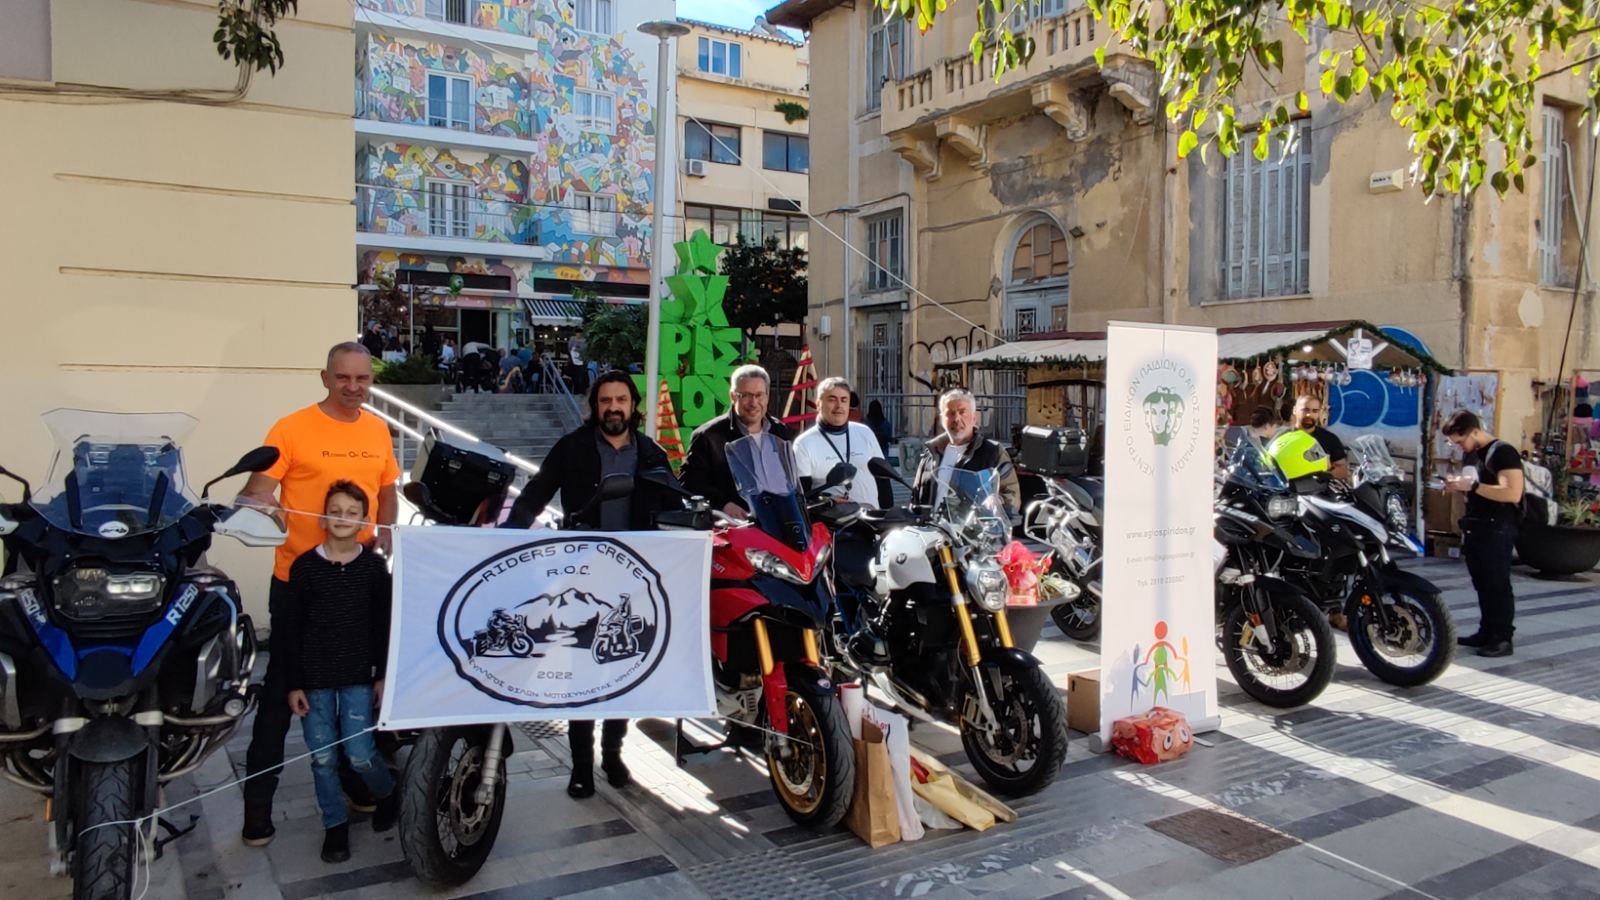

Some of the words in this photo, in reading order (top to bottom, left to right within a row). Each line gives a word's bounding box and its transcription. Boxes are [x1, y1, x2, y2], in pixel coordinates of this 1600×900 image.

[1140, 359, 1177, 380] ΠΑΙΔΙΩΝ
[1126, 436, 1155, 477] ΚΕΝΤΡΟ
[482, 545, 557, 582] RIDERS
[564, 543, 589, 554] OF
[596, 543, 644, 580] CRETE
[165, 608, 182, 626] R
[537, 671, 573, 680] 2022
